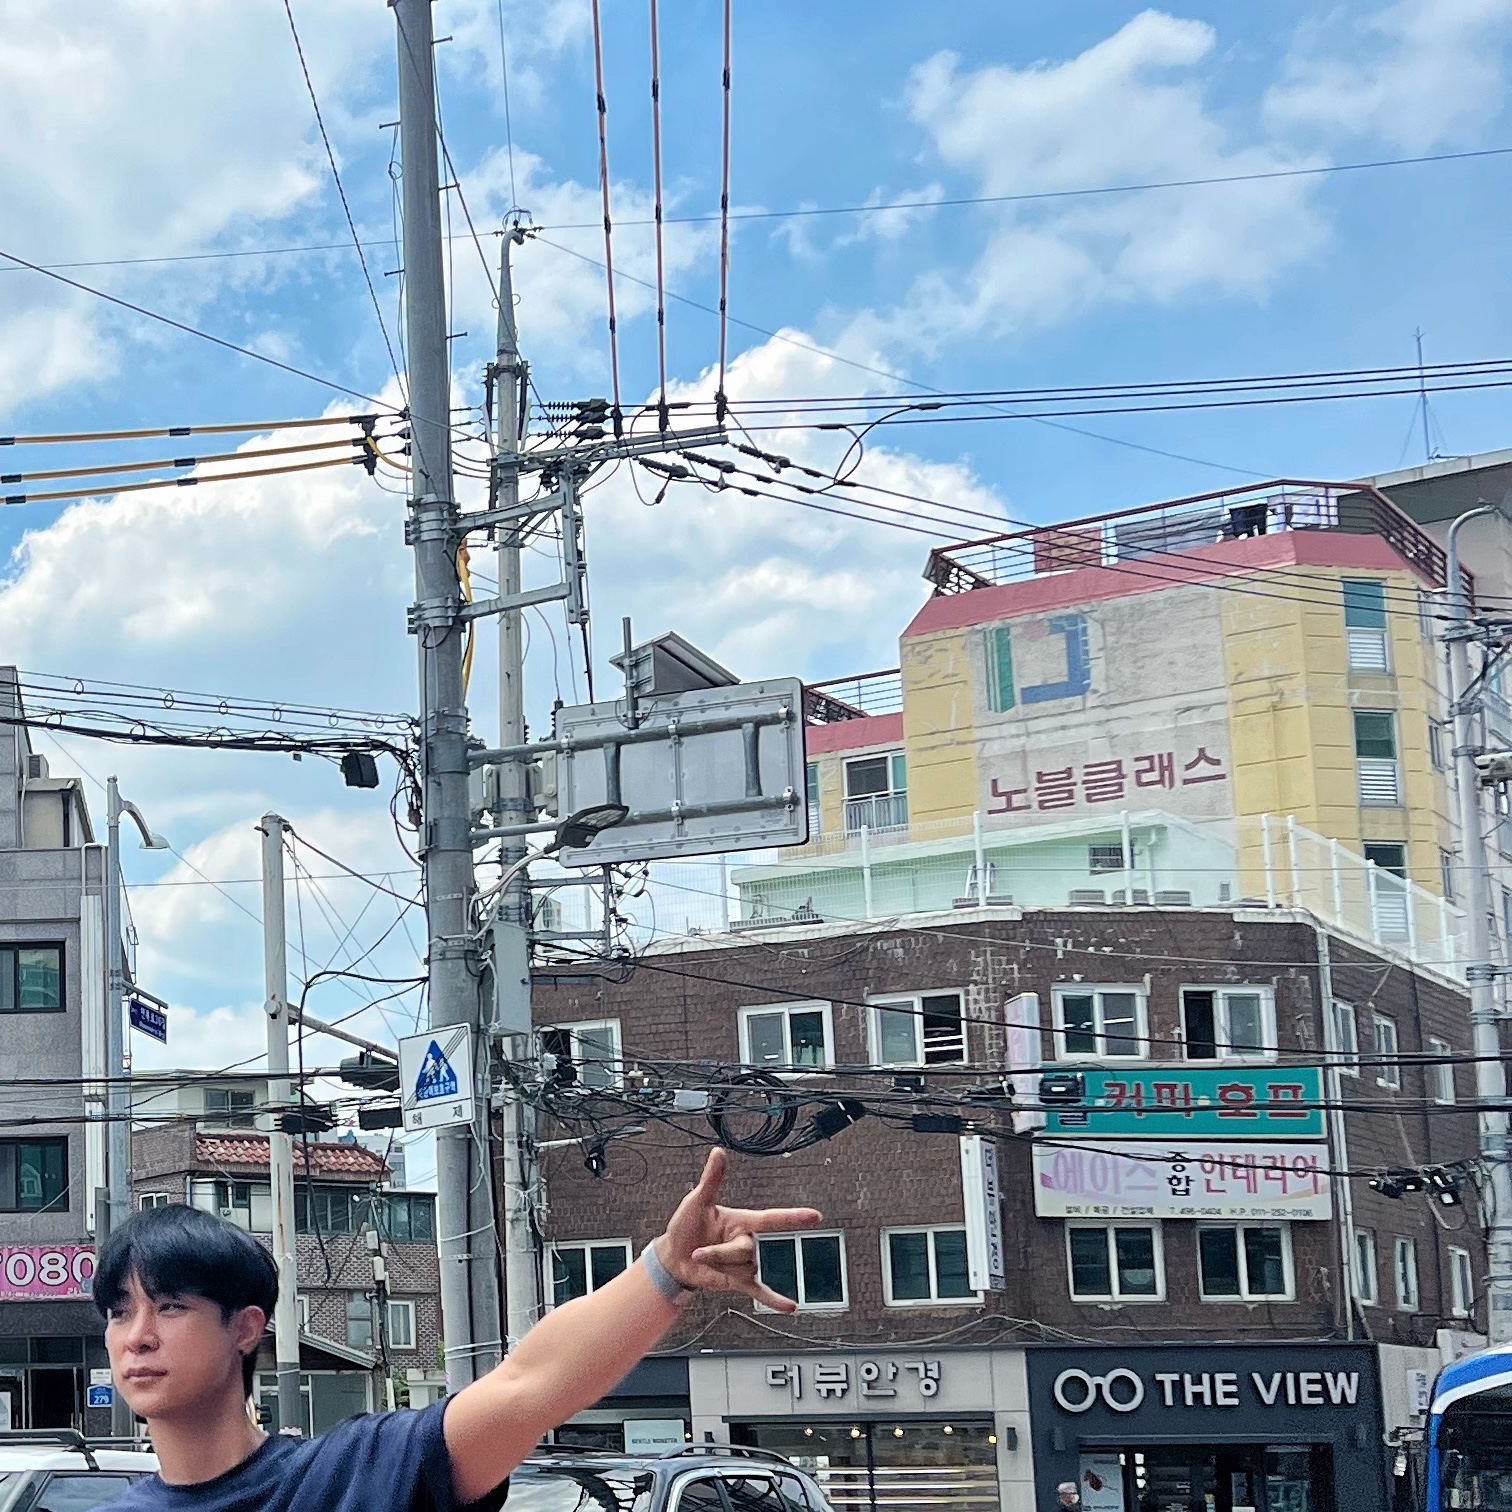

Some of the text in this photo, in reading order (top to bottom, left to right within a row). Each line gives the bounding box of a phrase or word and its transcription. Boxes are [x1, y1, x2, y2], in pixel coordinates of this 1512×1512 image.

[987, 747, 1227, 815] 노블클래스
[1053, 1150, 1160, 1195] 에이스
[1199, 1152, 1322, 1195] 인테리어
[765, 1360, 941, 1399] 더뷰안경
[1154, 1372, 1360, 1407] THE VIEW
[93, 1395, 110, 1405] 279
